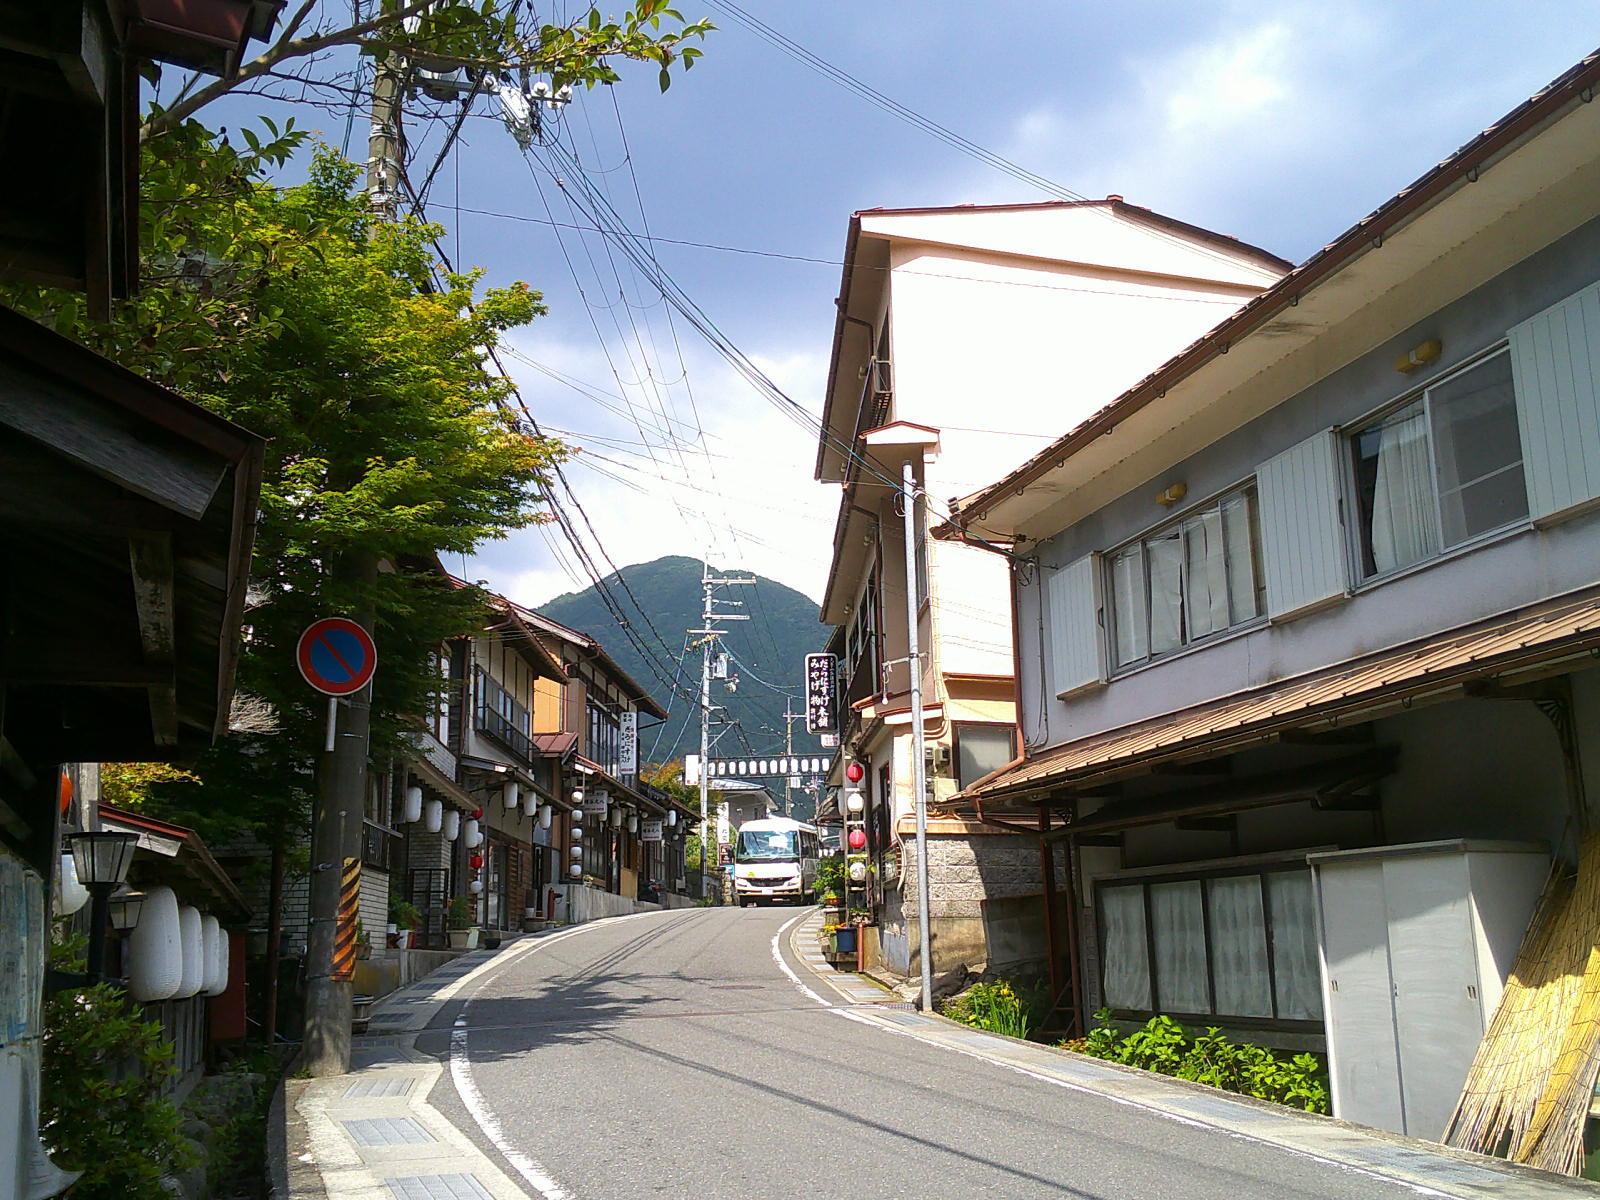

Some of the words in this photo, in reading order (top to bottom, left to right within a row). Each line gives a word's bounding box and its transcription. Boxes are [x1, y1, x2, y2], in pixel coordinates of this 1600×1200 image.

[817, 658, 829, 727] だらにすけ本舗
